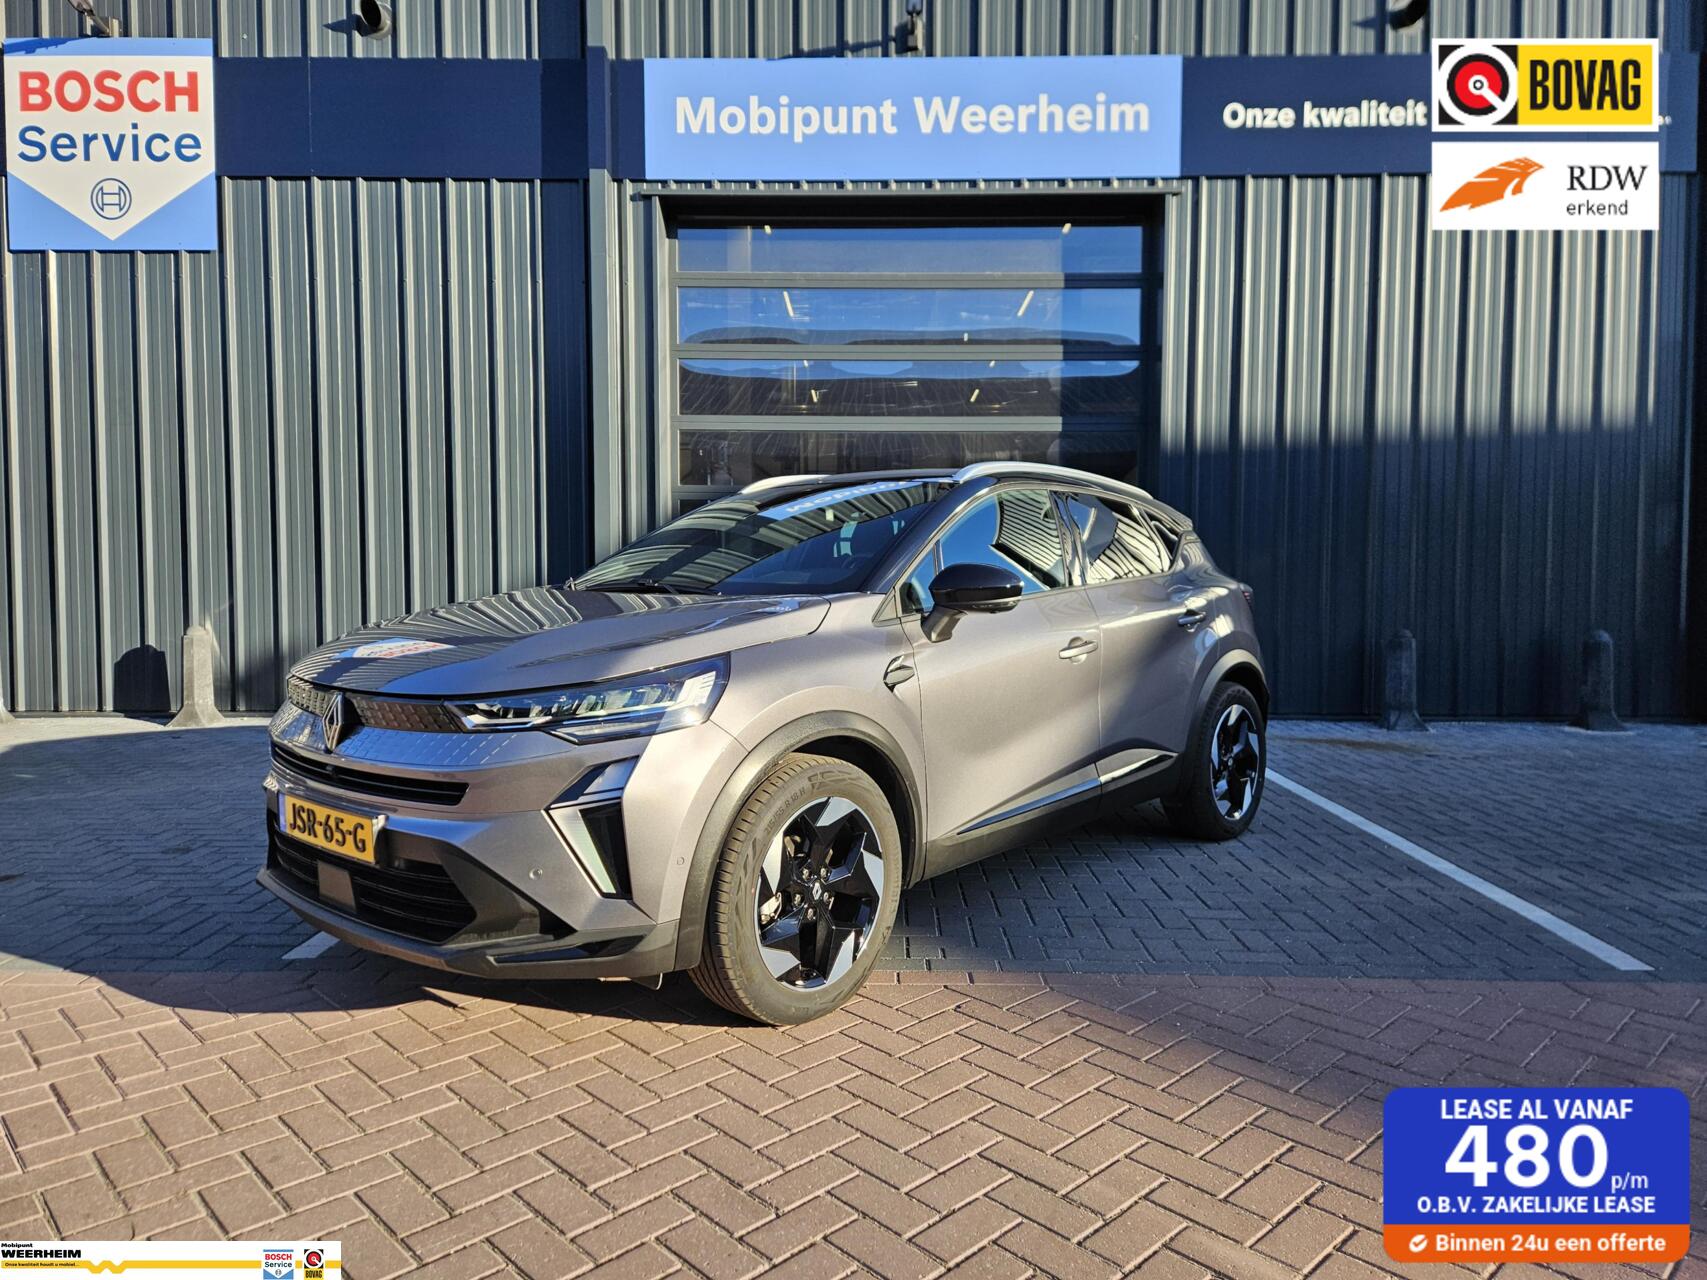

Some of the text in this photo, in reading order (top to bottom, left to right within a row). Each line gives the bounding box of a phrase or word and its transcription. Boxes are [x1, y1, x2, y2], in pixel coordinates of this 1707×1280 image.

[19, 70, 199, 113] BOSCH
[675, 92, 1150, 143] Mobipunt Weerheim
[1222, 99, 1428, 129] Onze kwaliteit
[17, 122, 202, 163] Service
[289, 803, 366, 853] JSR-65-G
